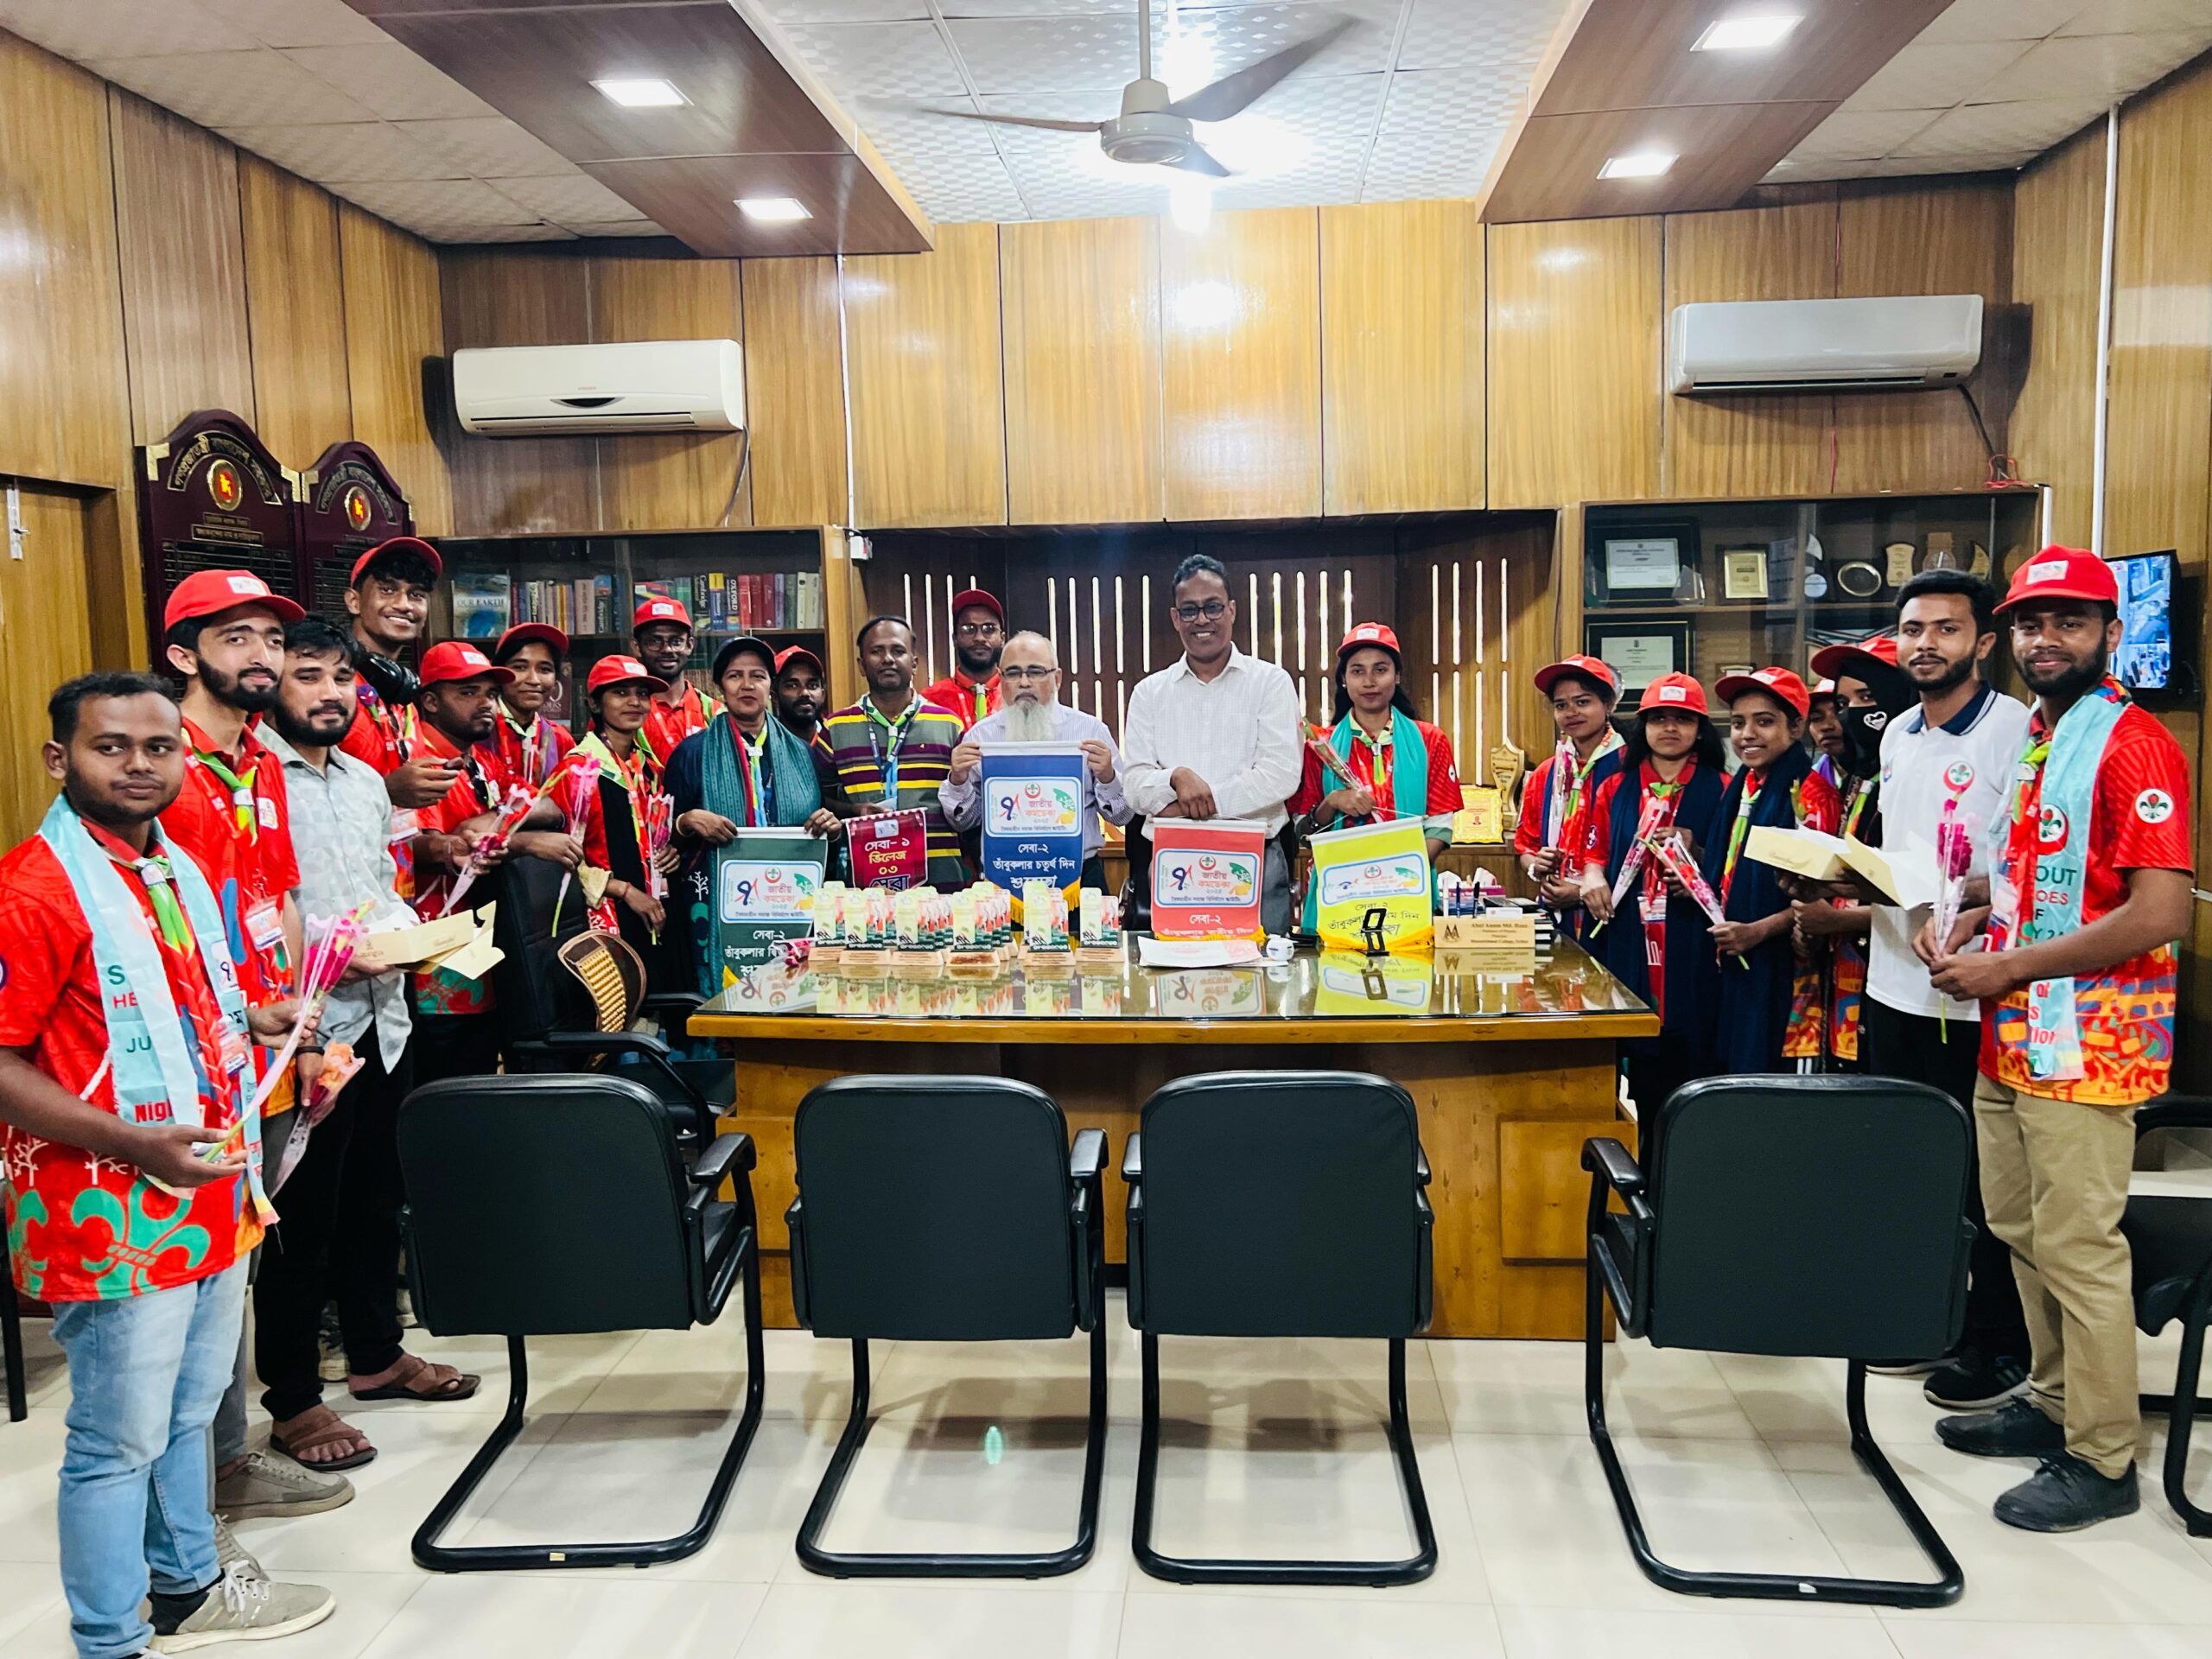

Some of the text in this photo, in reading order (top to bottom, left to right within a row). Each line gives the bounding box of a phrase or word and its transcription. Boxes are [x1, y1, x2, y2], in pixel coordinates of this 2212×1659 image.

[699, 575, 708, 608] Cambridge
[868, 850, 908, 864] ভিলেজ
[1059, 857, 1076, 870] দিন
[2035, 865, 2077, 887] OUT
[2036, 889, 2069, 906] OES
[2034, 908, 2045, 920] F
[126, 1035, 152, 1053] JU
